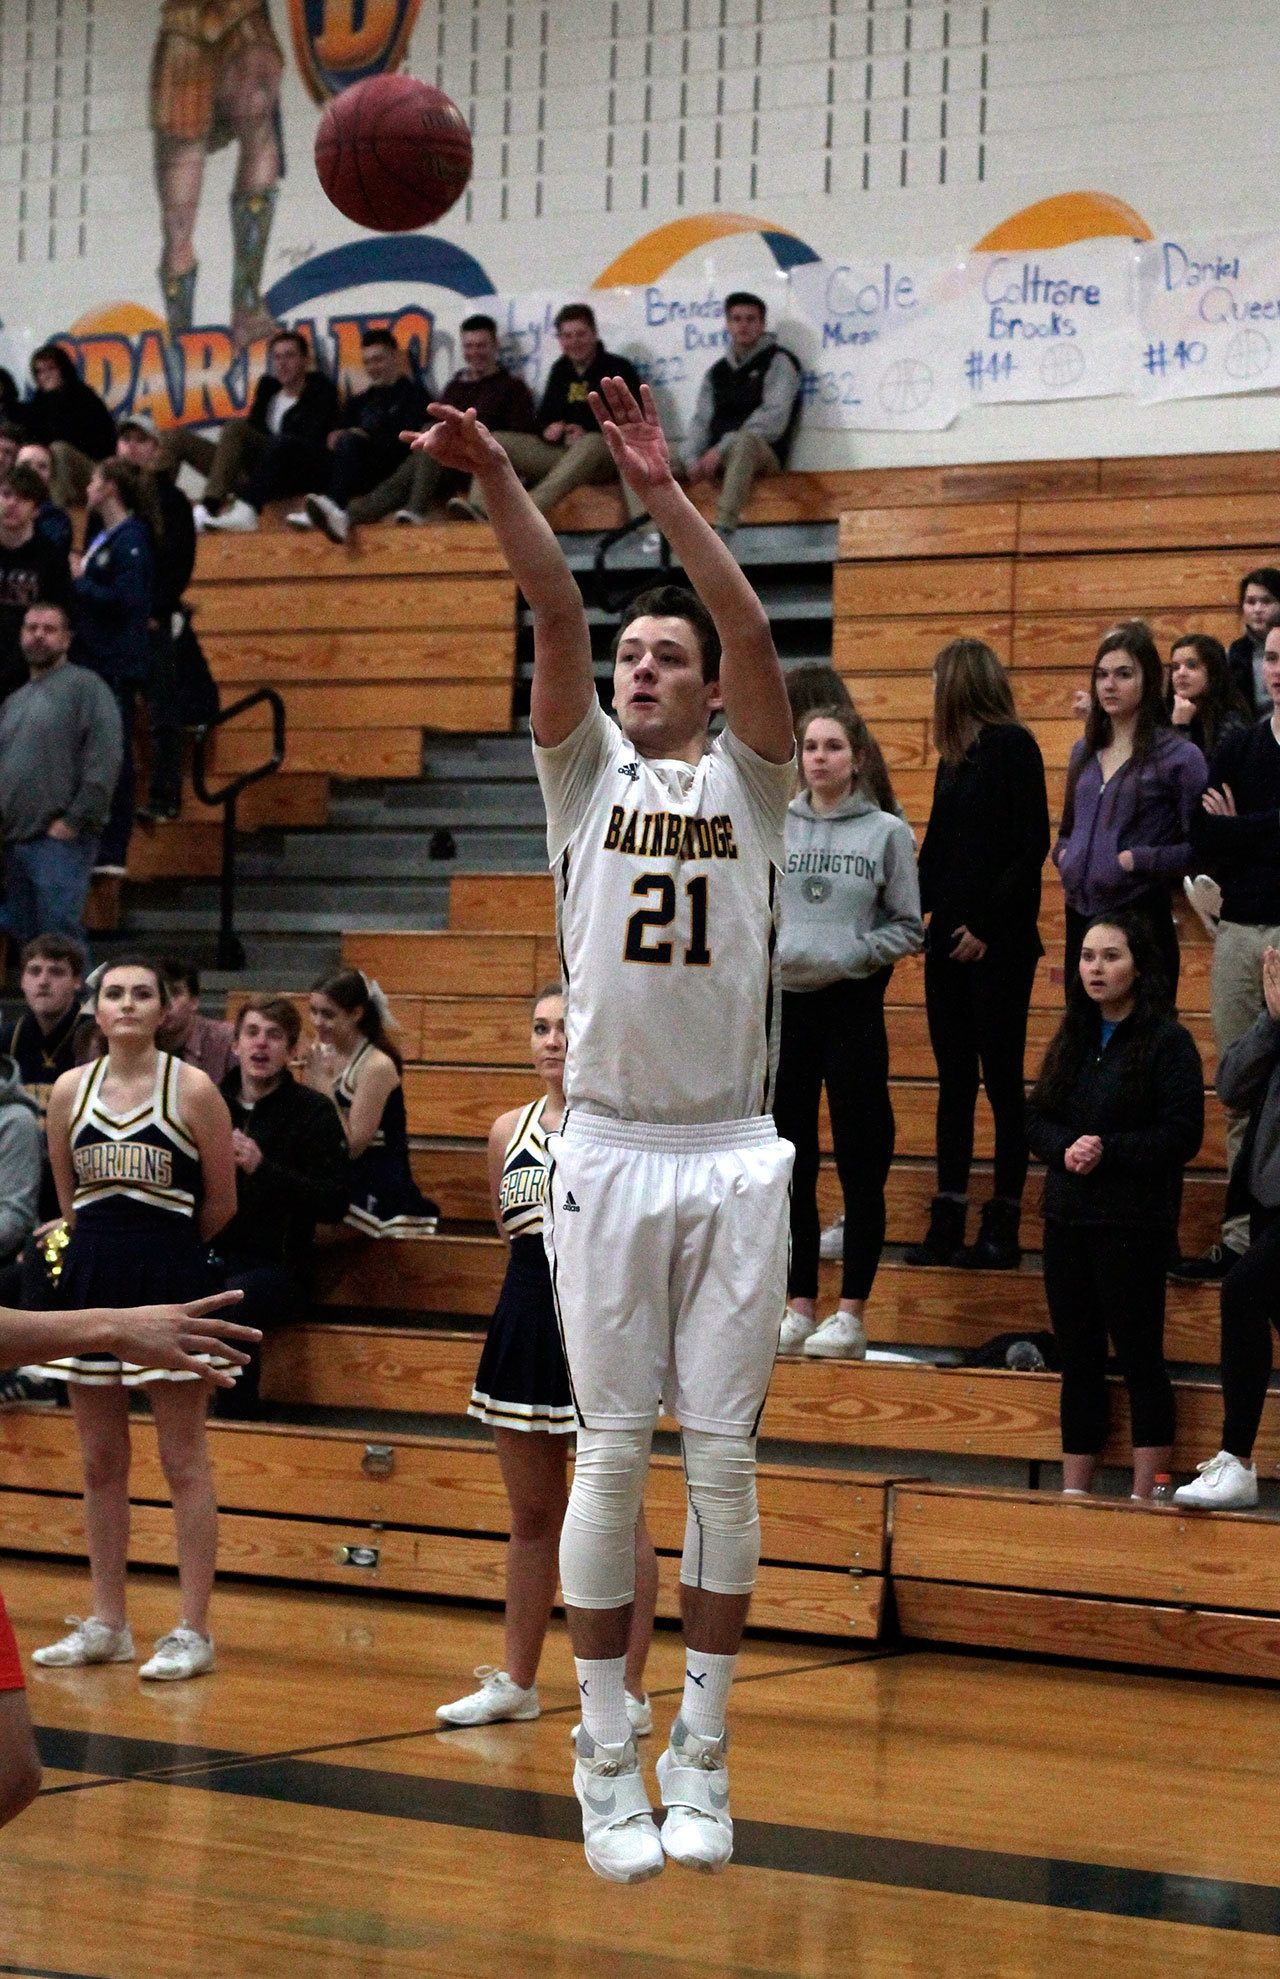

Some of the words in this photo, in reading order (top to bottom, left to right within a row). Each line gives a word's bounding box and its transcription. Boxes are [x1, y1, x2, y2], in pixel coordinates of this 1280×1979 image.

[825, 263, 917, 316] Cole
[982, 256, 1101, 306] Coltrane
[989, 306, 1077, 340] Brooks
[1143, 340, 1208, 376] #40
[782, 852, 877, 881] SHINGTON
[622, 872, 713, 968] 21
[500, 1169, 547, 1209] SPAR
